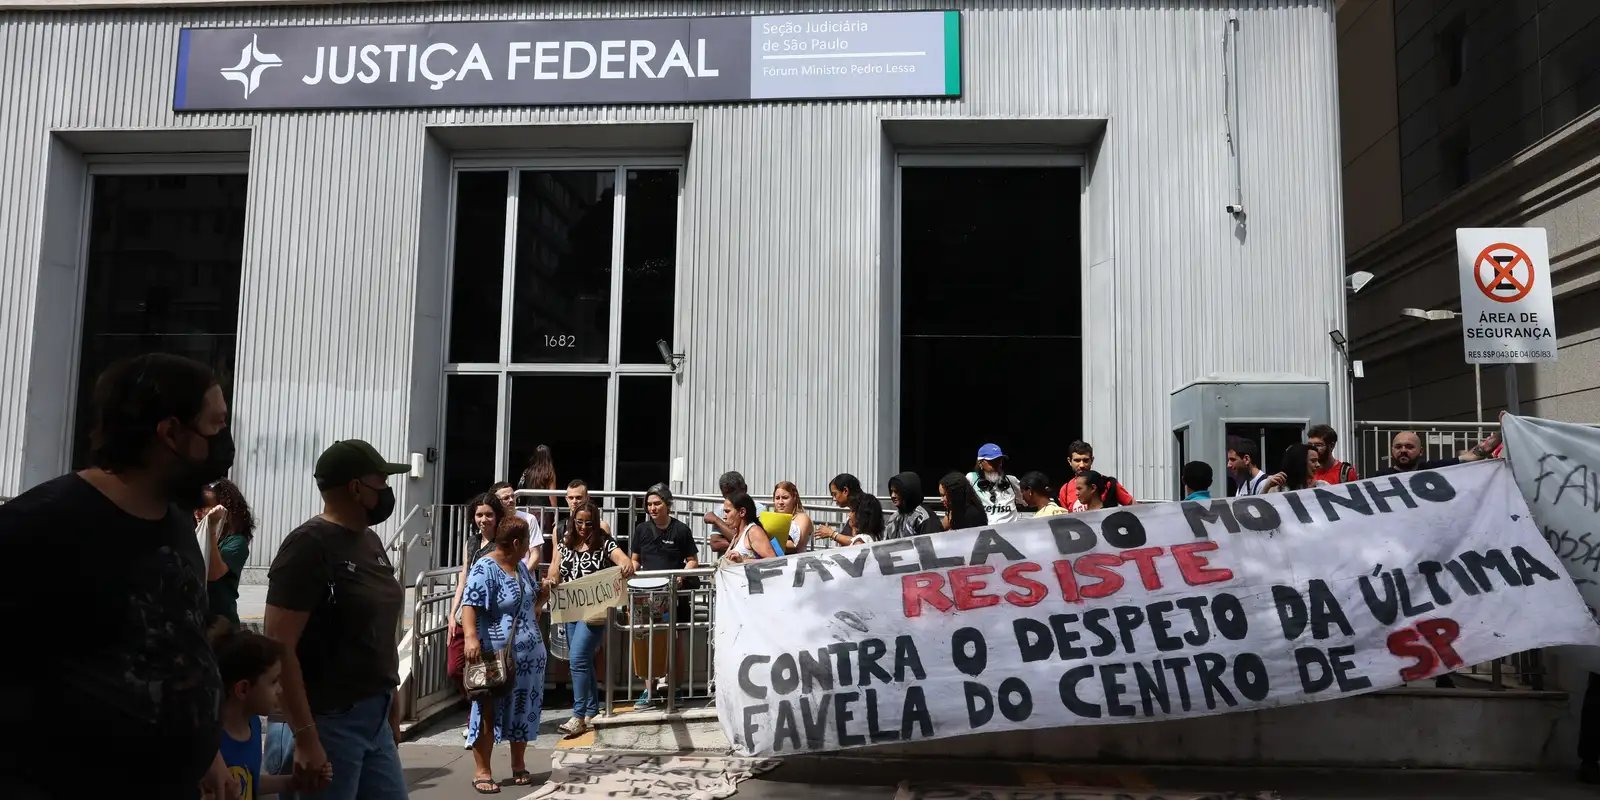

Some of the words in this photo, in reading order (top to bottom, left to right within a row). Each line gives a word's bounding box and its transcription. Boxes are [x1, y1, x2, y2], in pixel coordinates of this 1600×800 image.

[763, 21, 802, 36] Seção
[806, 20, 868, 34] Judiciária
[763, 40, 779, 51] de
[783, 38, 807, 51] São
[811, 38, 849, 50] Paulo
[302, 43, 493, 90] JUSTIÇA
[508, 38, 719, 80] FEDERAL
[763, 65, 798, 77] Fórum
[801, 64, 848, 76] Ministro
[851, 63, 883, 75] Pedro
[886, 63, 916, 74] Lessa
[1479, 311, 1516, 323] ÁREA
[1520, 312, 1538, 323] DE
[544, 334, 576, 348] 1682
[1467, 327, 1551, 340] SEGURANÇA
[984, 504, 1012, 515] efisa
[745, 529, 1025, 594] FAVELA
[1048, 511, 1147, 555] DO
[1182, 471, 1456, 538] MOINHO
[1545, 525, 1600, 573] OSSA
[902, 541, 1234, 618] RESISTE
[738, 635, 927, 700] CONTRA
[951, 626, 988, 677] O
[1013, 593, 1249, 663] DESPEJO
[1271, 579, 1356, 641] DA
[1358, 545, 1560, 626] ÚLTIMA
[743, 686, 935, 753] FAVELA
[964, 676, 1033, 729] DO
[1058, 653, 1269, 719] CENTRO
[1296, 645, 1372, 695] DE
[1386, 617, 1465, 682] SP
